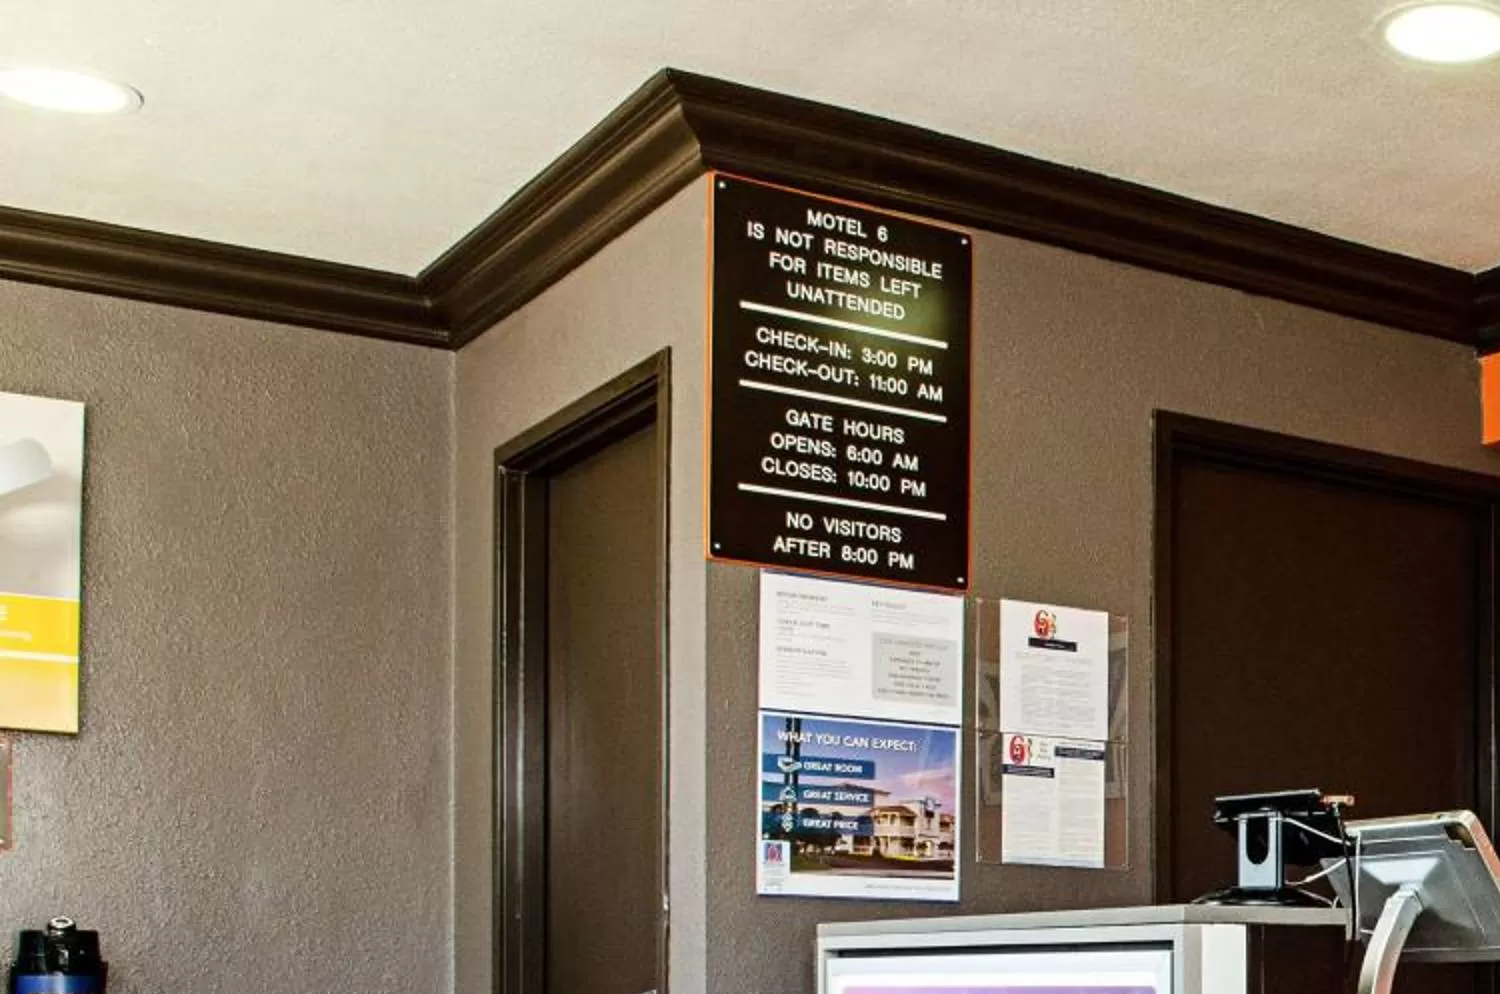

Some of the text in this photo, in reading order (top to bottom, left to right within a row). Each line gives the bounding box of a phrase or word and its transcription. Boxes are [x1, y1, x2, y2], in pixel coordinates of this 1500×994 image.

[806, 208, 888, 242] MOTEL 6
[747, 220, 942, 280] IS NOT RESPONSIBLE
[769, 251, 921, 299] FOR ITEMS LEFT
[786, 281, 905, 320] UNATTENDED
[756, 326, 933, 376] CHECK-IN: 3:00 PM
[744, 350, 943, 402] CHECK-OUT: 11:00 AM
[785, 408, 905, 444] GATE HOURS
[770, 432, 919, 472] OPENS: 6:00 AM
[761, 456, 926, 498] CLOSES: 10:00 PM
[786, 511, 902, 544] NO VISITORS
[773, 535, 914, 570] AFTER 8:00 PM
[777, 730, 813, 744] WHAT
[815, 733, 841, 747] YOU
[843, 736, 869, 749] CAN
